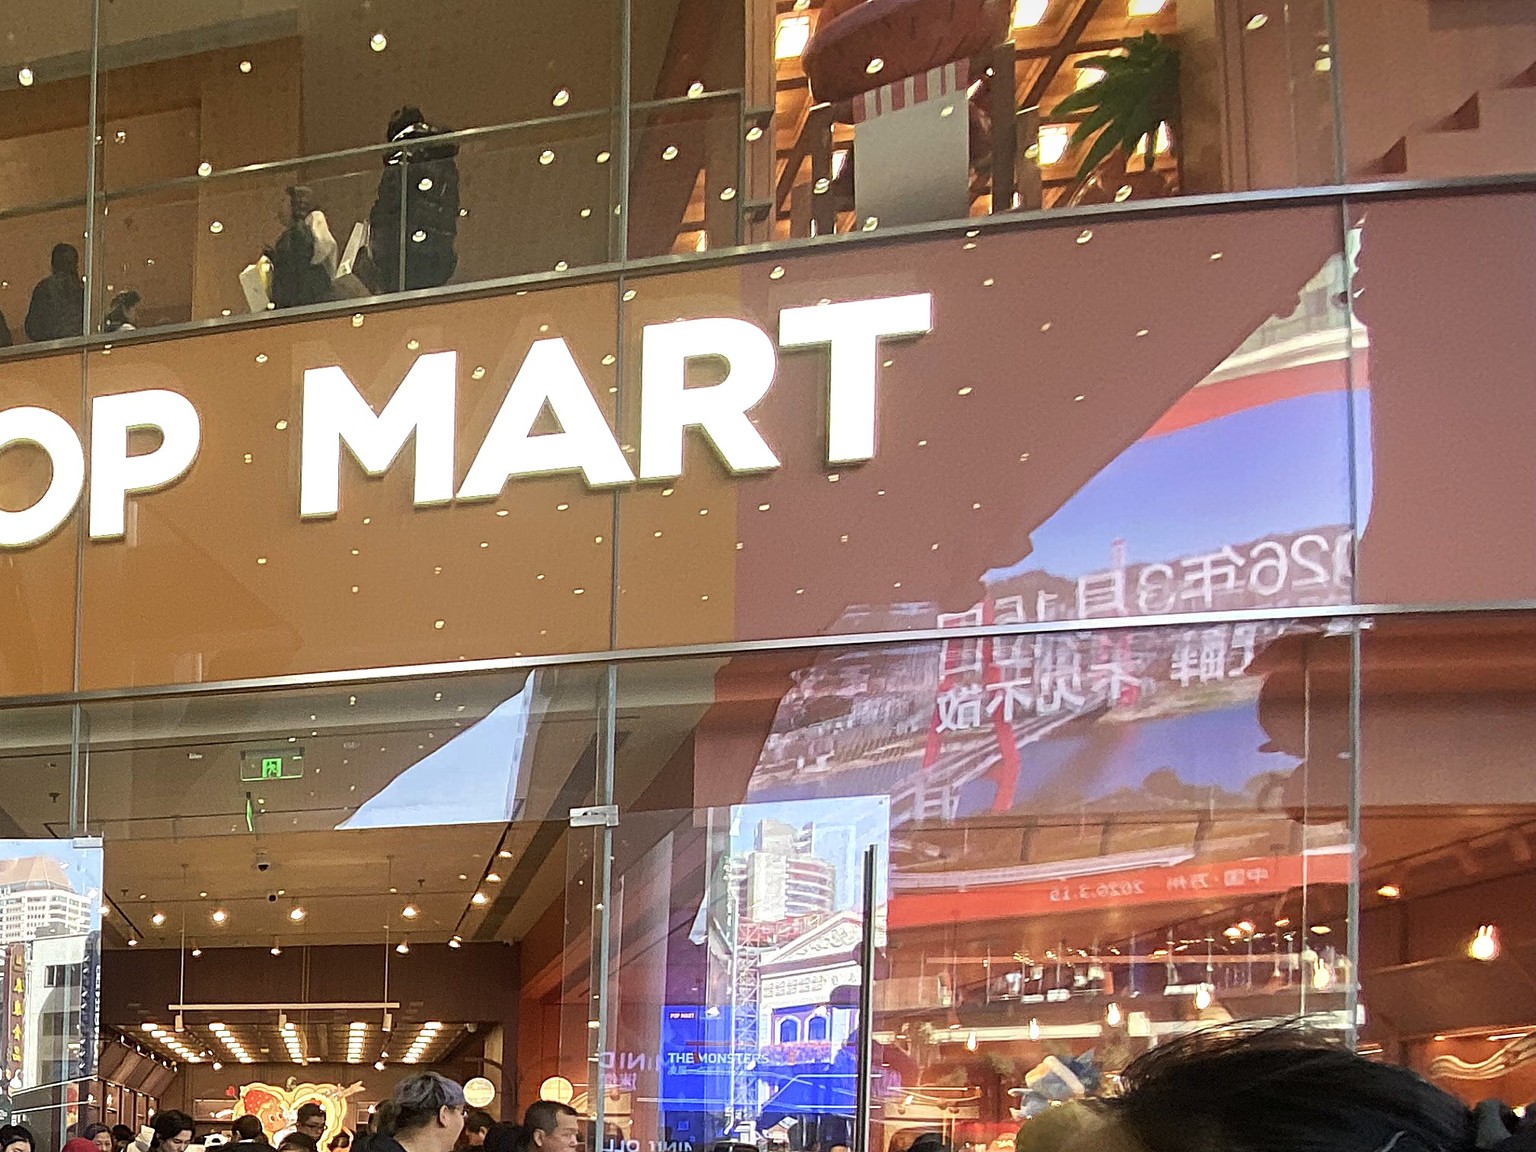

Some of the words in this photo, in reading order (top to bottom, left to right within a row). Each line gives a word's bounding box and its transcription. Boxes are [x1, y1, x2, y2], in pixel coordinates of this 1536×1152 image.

[300, 292, 935, 520] MART
[668, 1052, 694, 1065] THE
[696, 1052, 770, 1065] MONSTERS
